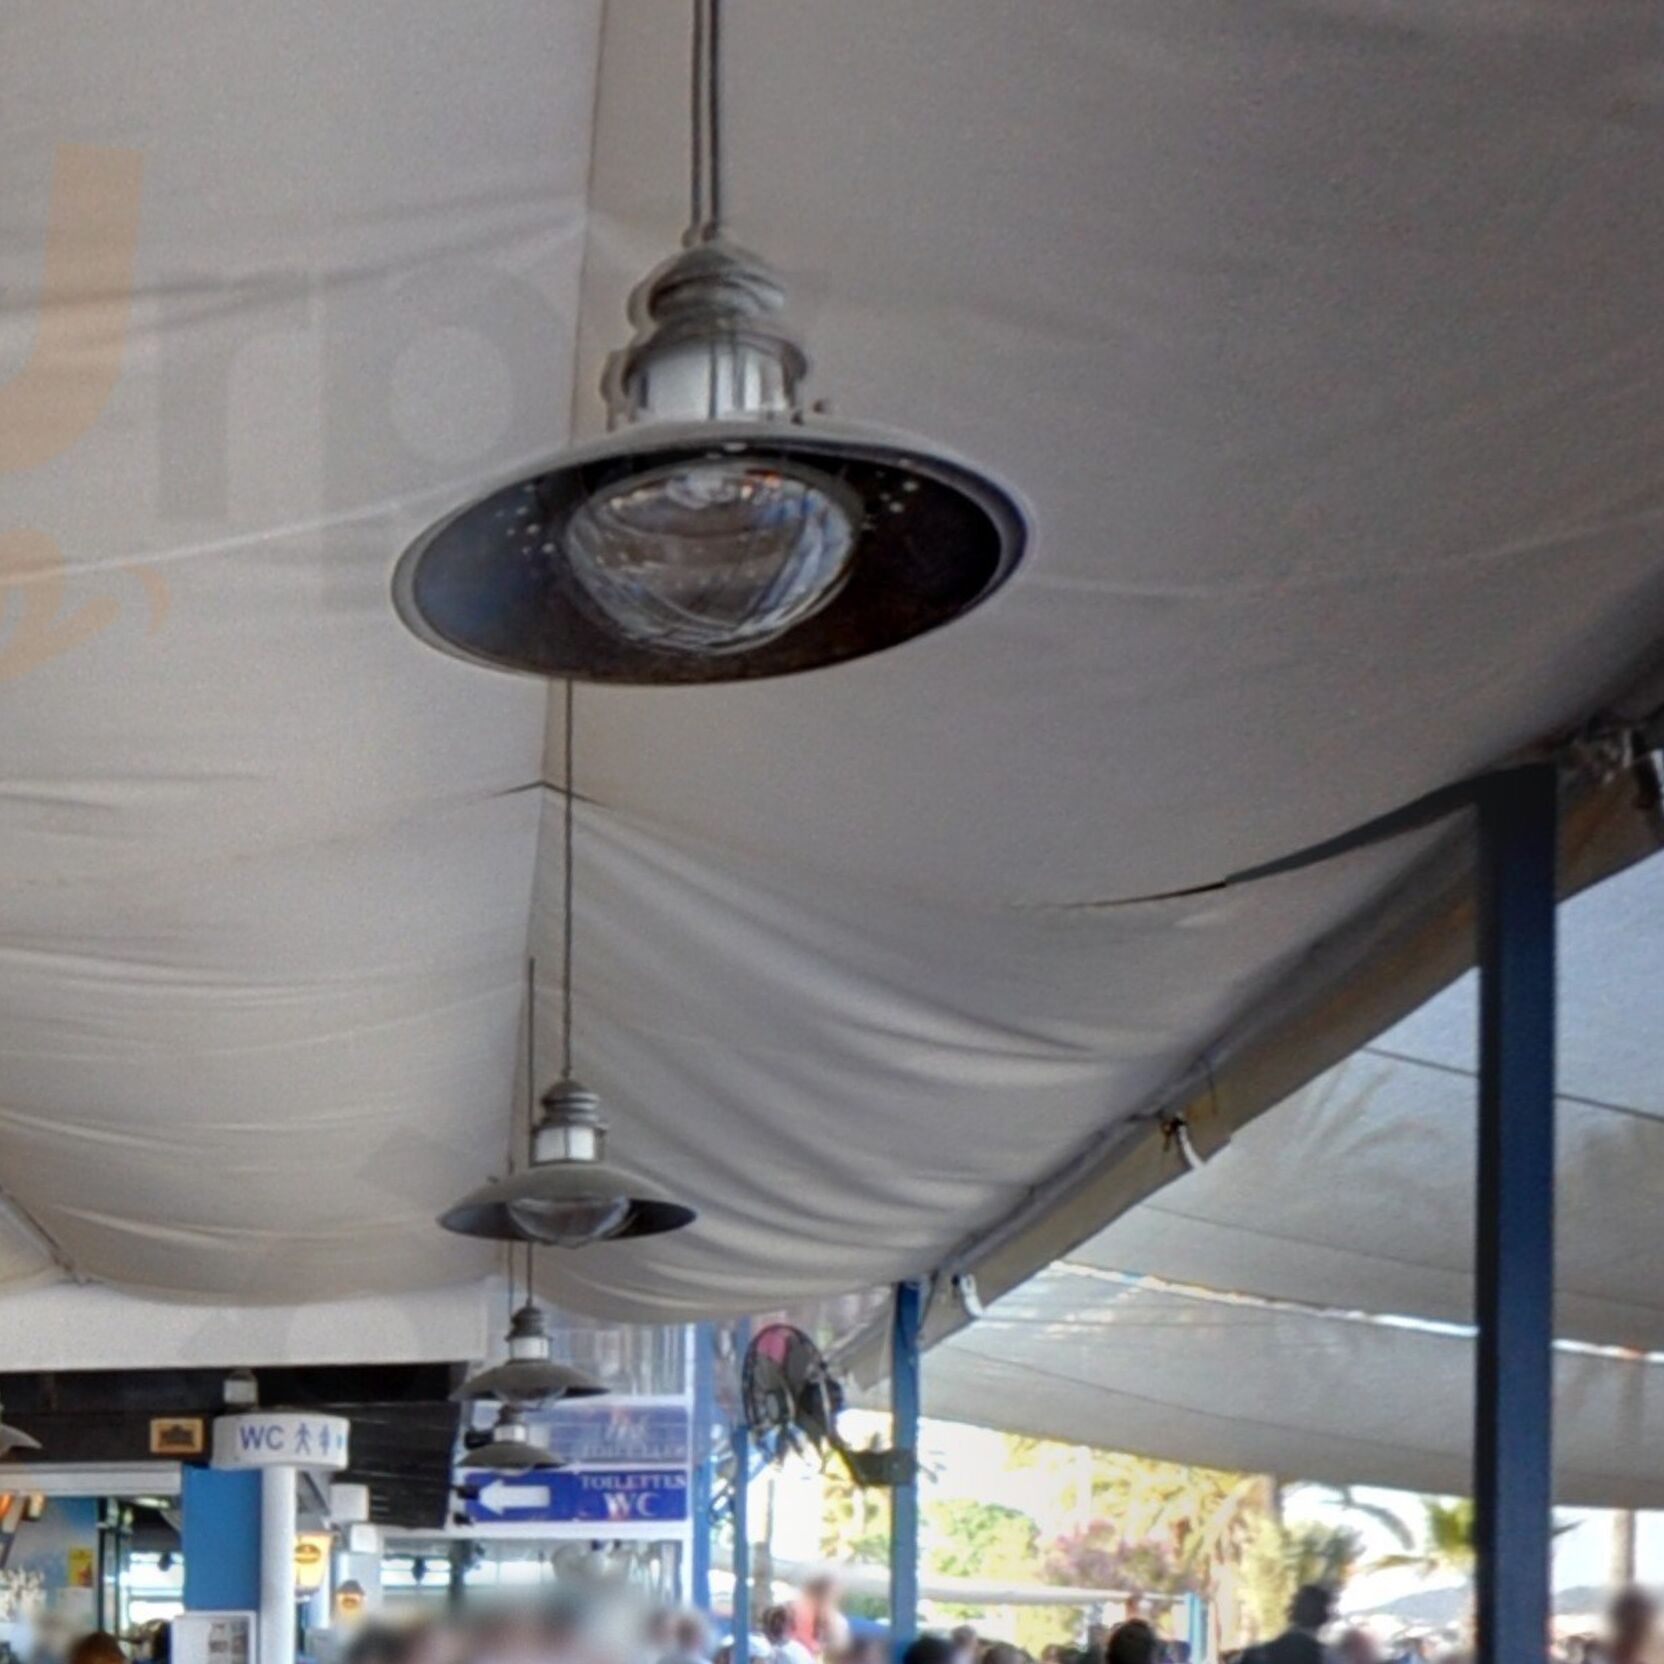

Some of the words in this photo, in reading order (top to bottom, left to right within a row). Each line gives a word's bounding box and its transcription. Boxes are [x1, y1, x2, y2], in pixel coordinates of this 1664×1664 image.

[239, 1424, 285, 1451] WC
[581, 1474, 687, 1490] TOILETTES
[603, 1491, 660, 1517] WC
